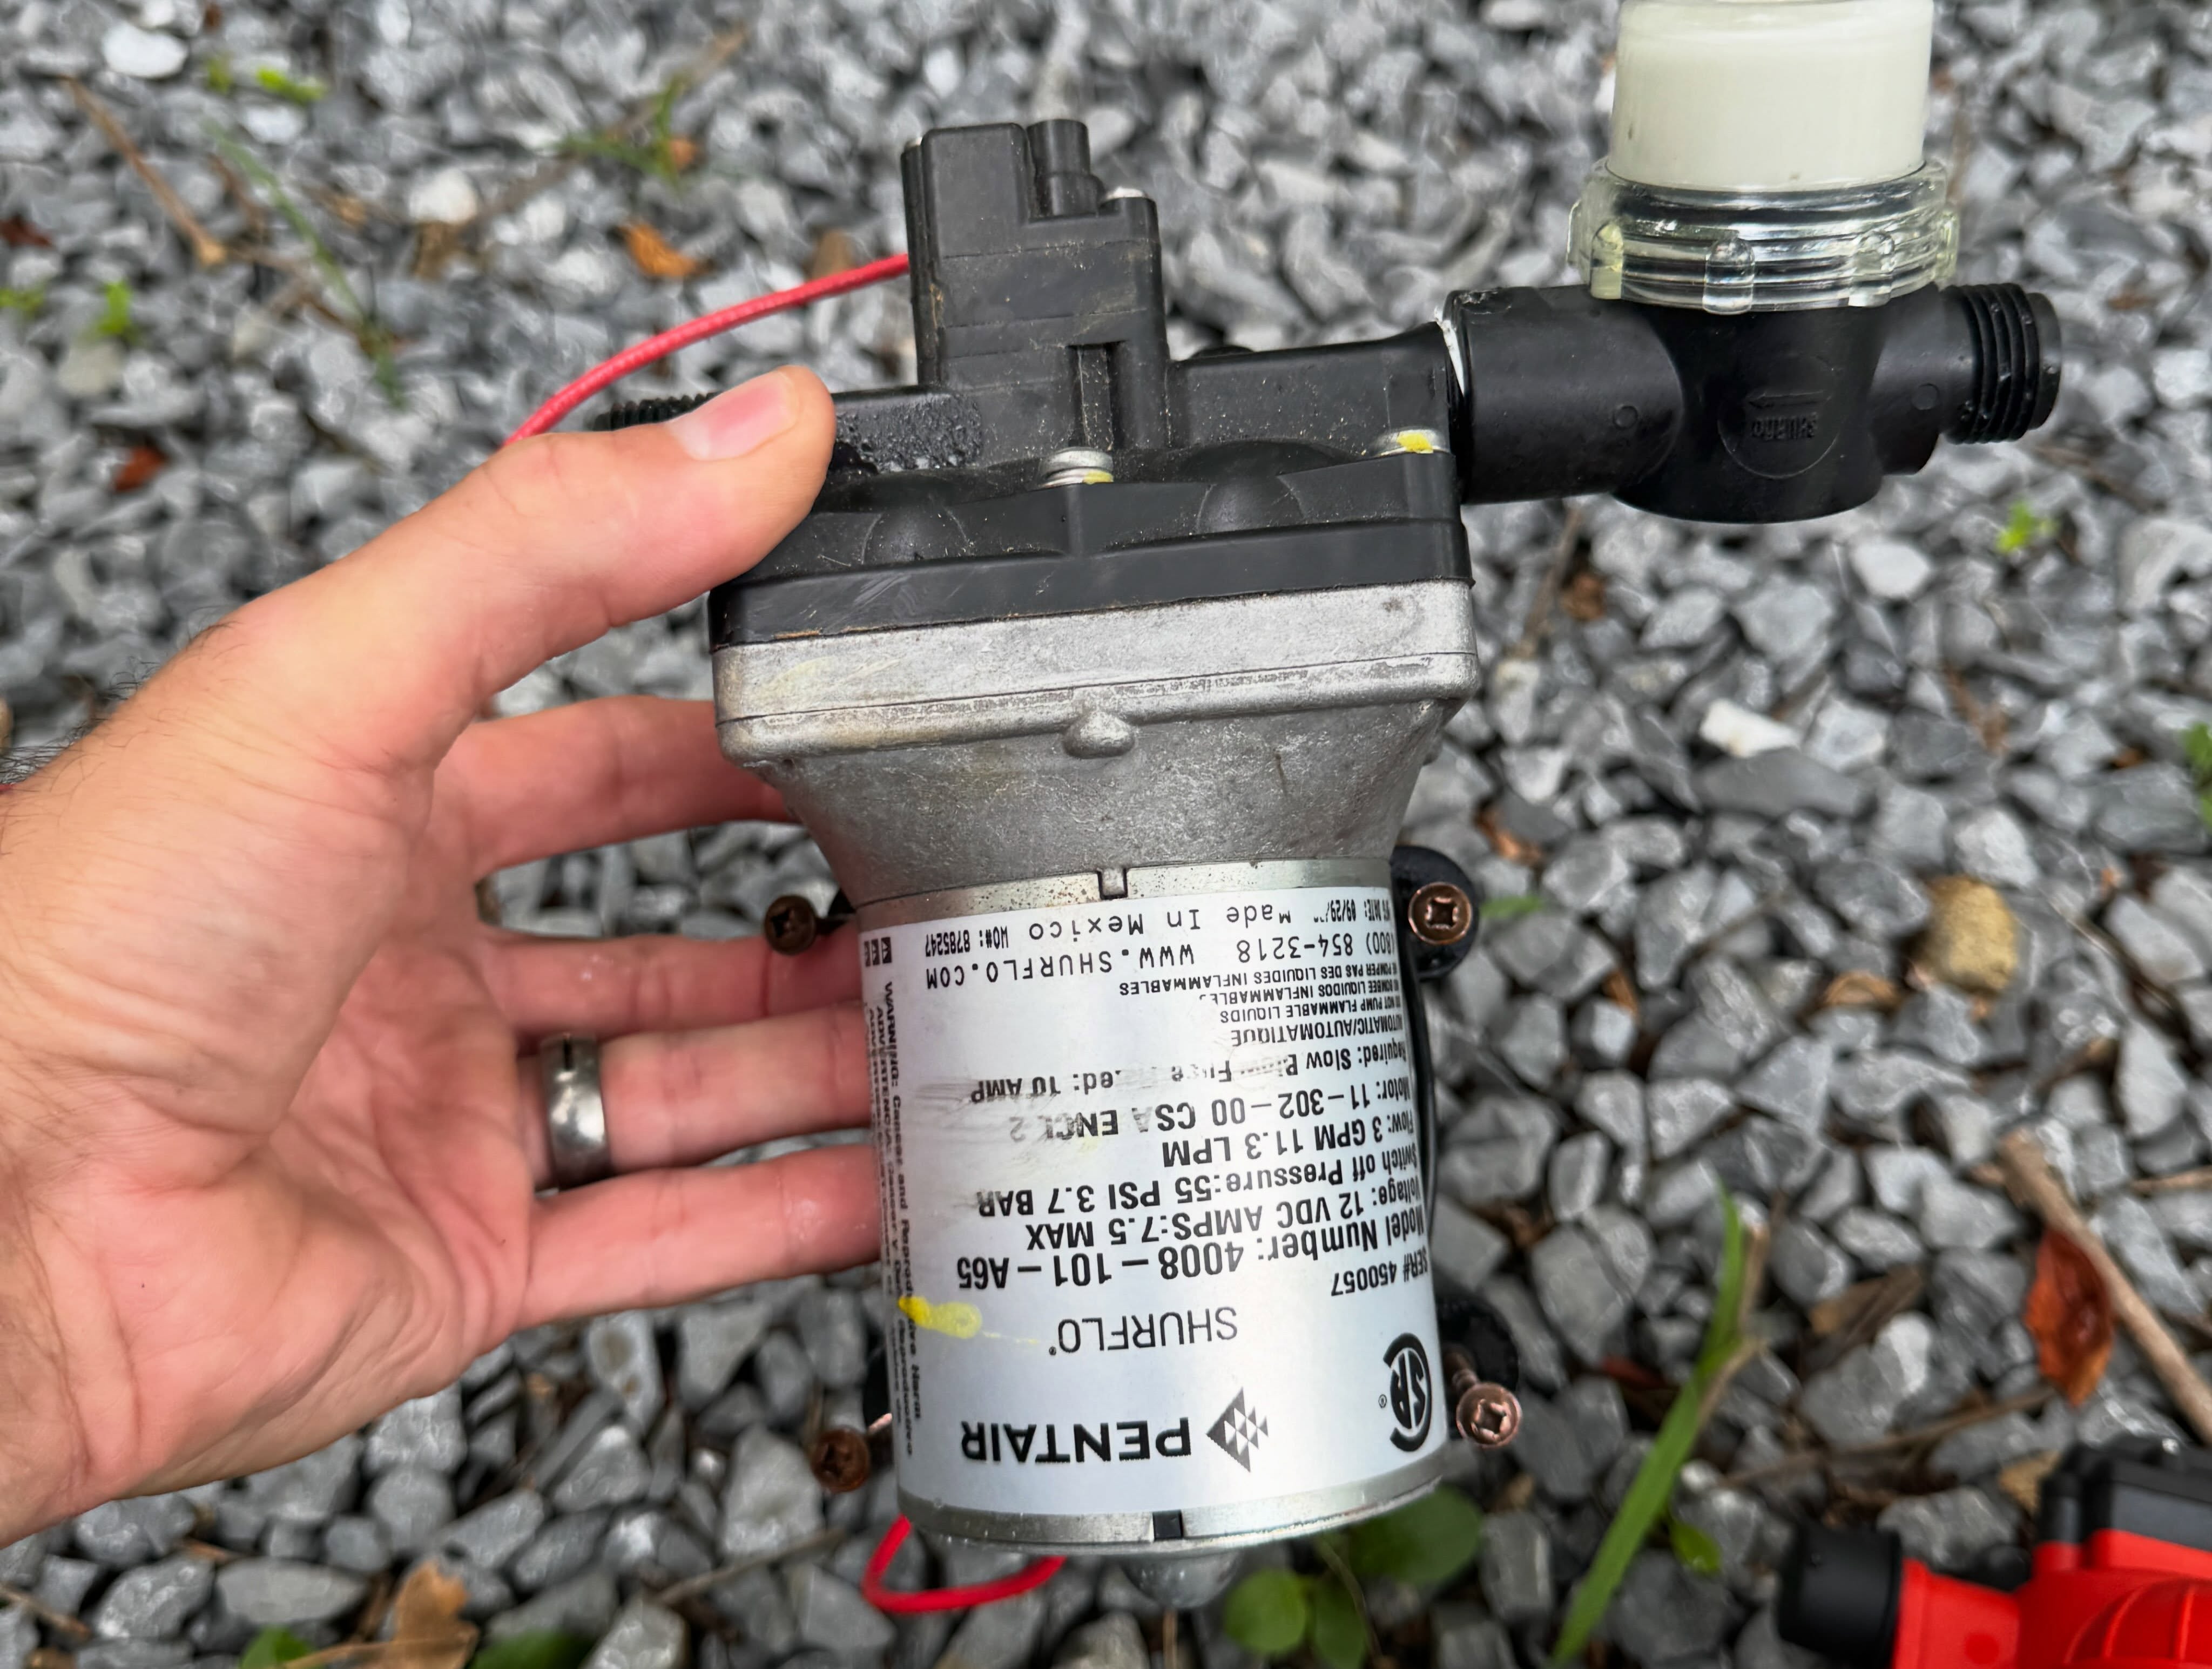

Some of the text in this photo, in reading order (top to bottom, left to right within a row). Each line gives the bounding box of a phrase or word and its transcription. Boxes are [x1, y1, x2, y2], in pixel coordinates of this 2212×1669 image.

[1029, 914, 1143, 942] Mexico
[1167, 909, 1200, 930] In
[1226, 904, 1291, 928] Made
[925, 929, 970, 957] 8785247
[979, 926, 1008, 950] WO#:
[926, 932, 1394, 989] (800) 854-3218 WWW.SHURFLO.COM
[1320, 965, 1341, 981] DES
[1345, 964, 1363, 979] PAS
[1119, 972, 1247, 996] INFLAMMABLES
[1253, 968, 1316, 985] LIQUIDES
[1318, 981, 1366, 997] LIQUIDOS
[1199, 986, 1313, 1005] INFLAMMABLE
[1286, 999, 1357, 1018] FLAMMABLE
[1361, 997, 1382, 1012] PUMP
[1219, 1006, 1280, 1024] LIQUIDS
[1230, 1013, 1403, 1047] AUTOMATIC/AUTOMATIQUE
[1306, 1048, 1351, 1071] Slow
[1358, 1037, 1407, 1066] Required:
[885, 982, 899, 1086] WARNING:
[898, 1174, 908, 1209] and
[970, 1078, 1022, 1103] AMP
[1031, 1076, 1061, 1097] 10
[1376, 1076, 1411, 1100] Motor:
[1008, 1116, 1026, 1143] 2
[1037, 1109, 1119, 1140] ENCL
[1131, 1102, 1196, 1133] CSA
[1162, 1109, 1414, 1167] Flow: 3 GPM 11.3 LPM
[1352, 1154, 1375, 1182] off
[1382, 1141, 1418, 1175] Switch
[976, 1189, 1034, 1217] BAR
[1048, 1185, 1095, 1214] 3.7
[1108, 1180, 1160, 1209] PSI
[1371, 1174, 1421, 1207] Voltage:
[1276, 1197, 1331, 1228] VDC
[1339, 1191, 1364, 1219] 12
[1025, 1221, 1094, 1250] MAX
[1385, 1204, 1425, 1246] Model
[1257, 1219, 1378, 1261] Number:
[1331, 1246, 1428, 1296] SER# 450057
[961, 1417, 1191, 1463] PENTAIR
